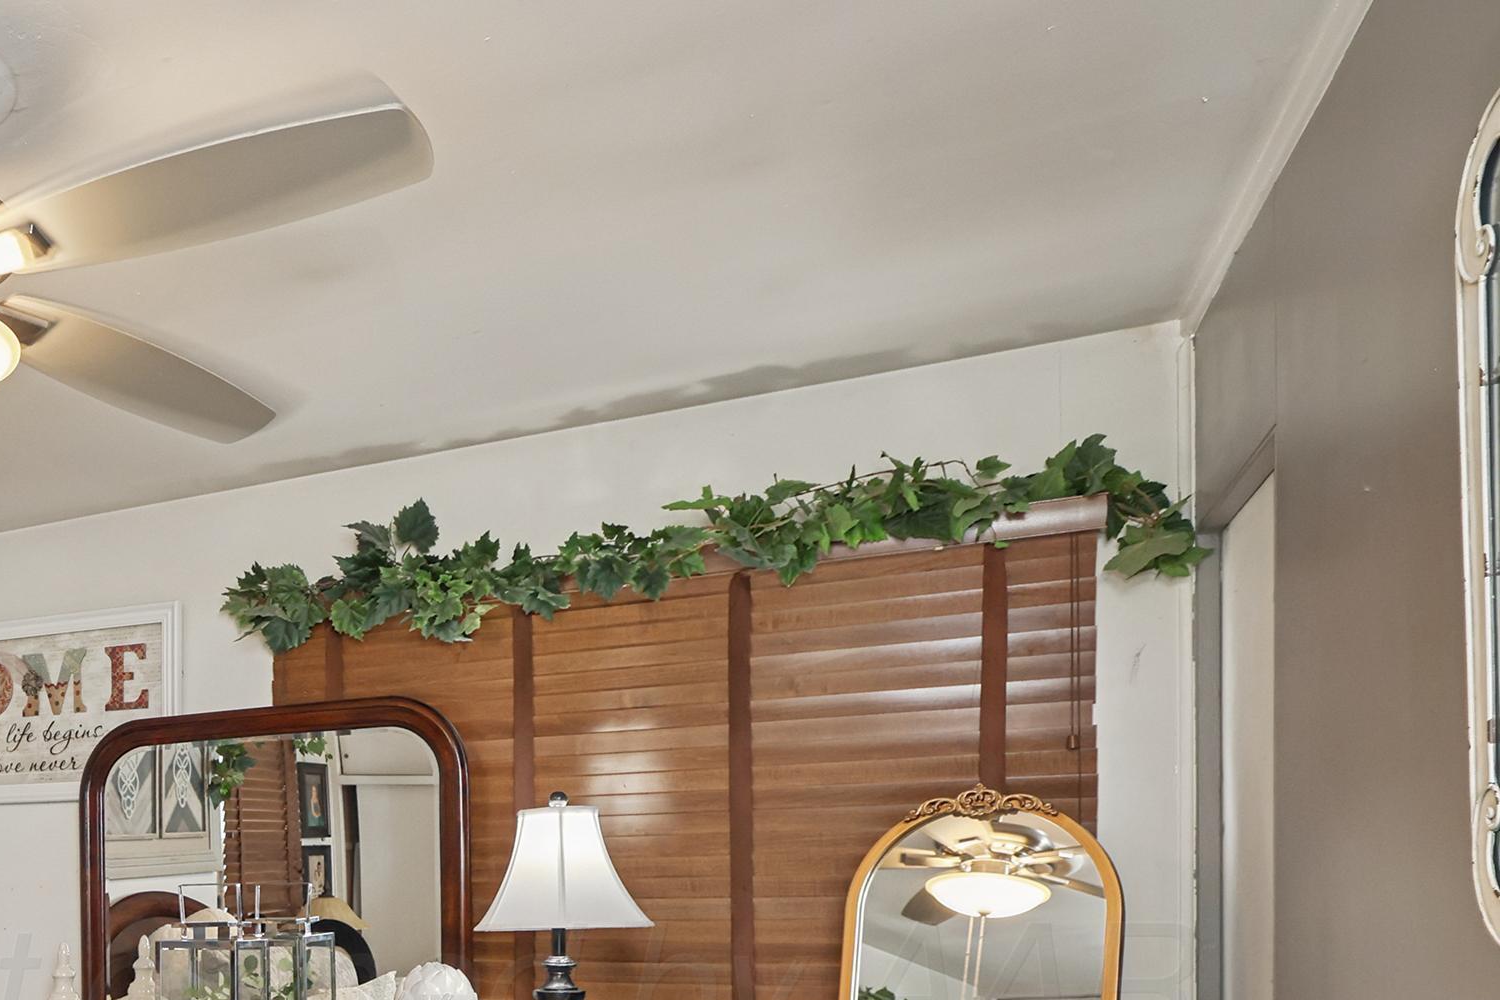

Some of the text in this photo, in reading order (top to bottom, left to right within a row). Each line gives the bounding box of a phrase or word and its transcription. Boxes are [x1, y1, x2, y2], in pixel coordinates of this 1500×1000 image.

[6, 723, 37, 752] life
[44, 721, 103, 755] begins
[29, 757, 81, 772] never
